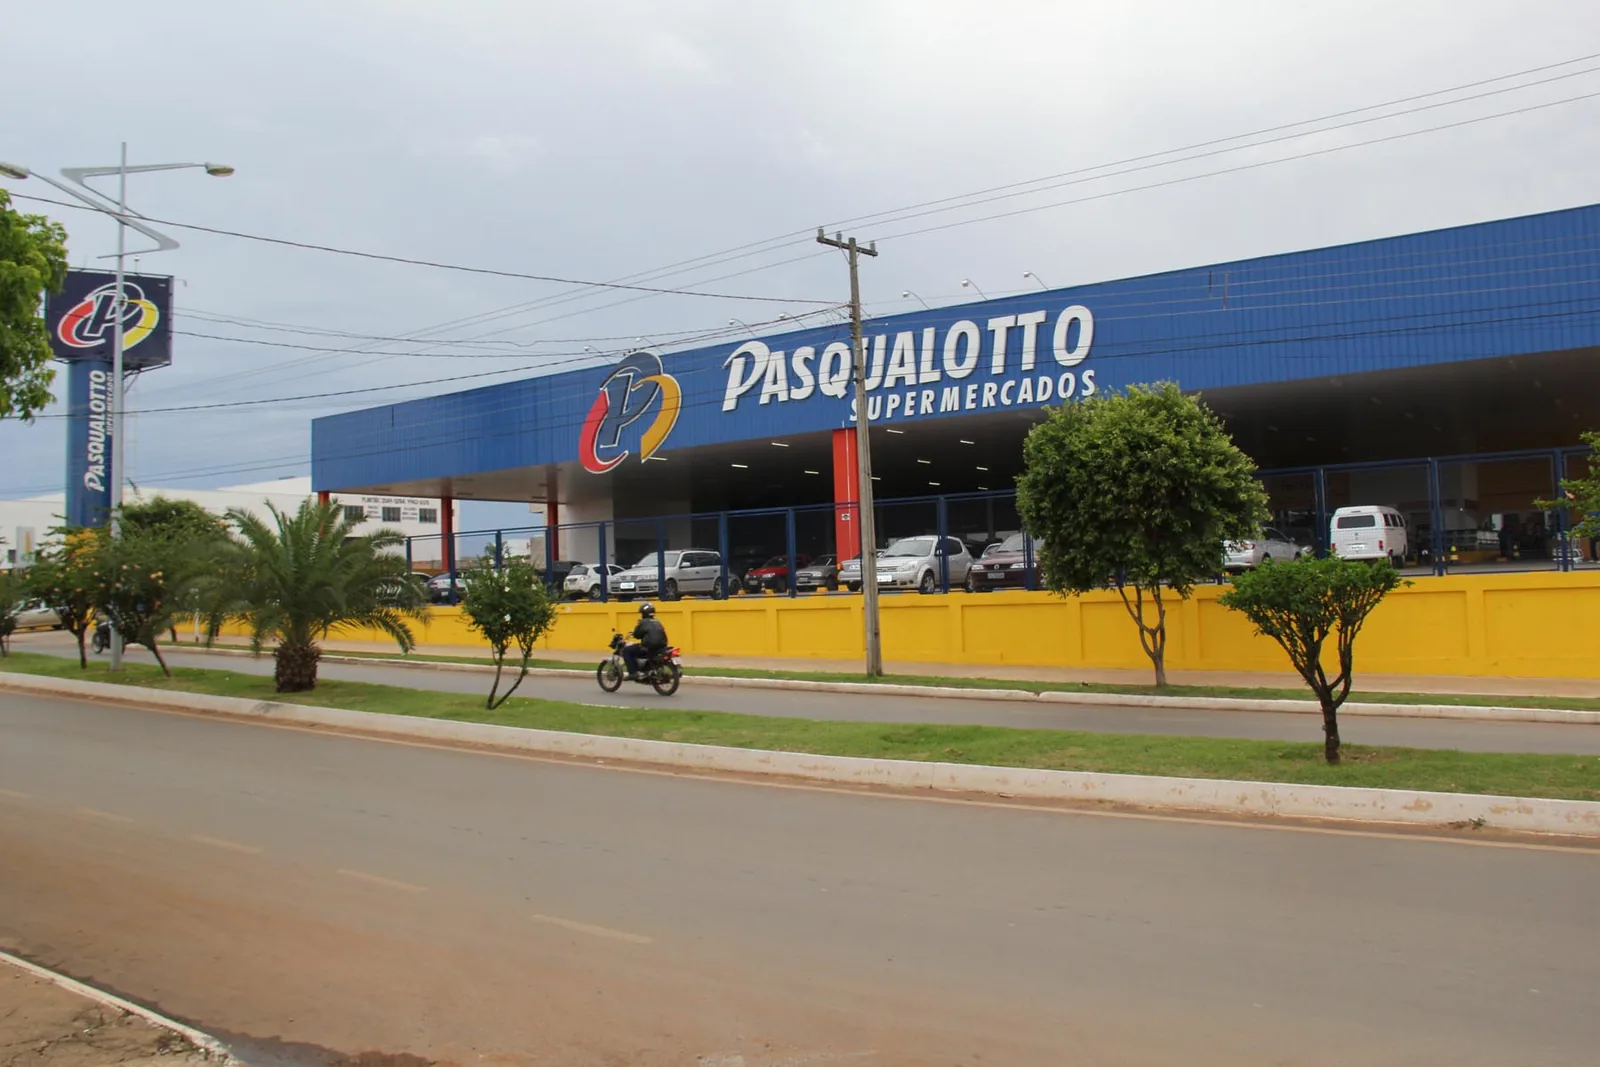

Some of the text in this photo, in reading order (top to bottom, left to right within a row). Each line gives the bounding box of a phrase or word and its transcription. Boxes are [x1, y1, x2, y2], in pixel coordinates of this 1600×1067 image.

[721, 305, 1095, 412] PASQUALOTTO
[849, 369, 1096, 422] SUPERMERCADOS
[84, 370, 107, 492] PASQUALOTTO
